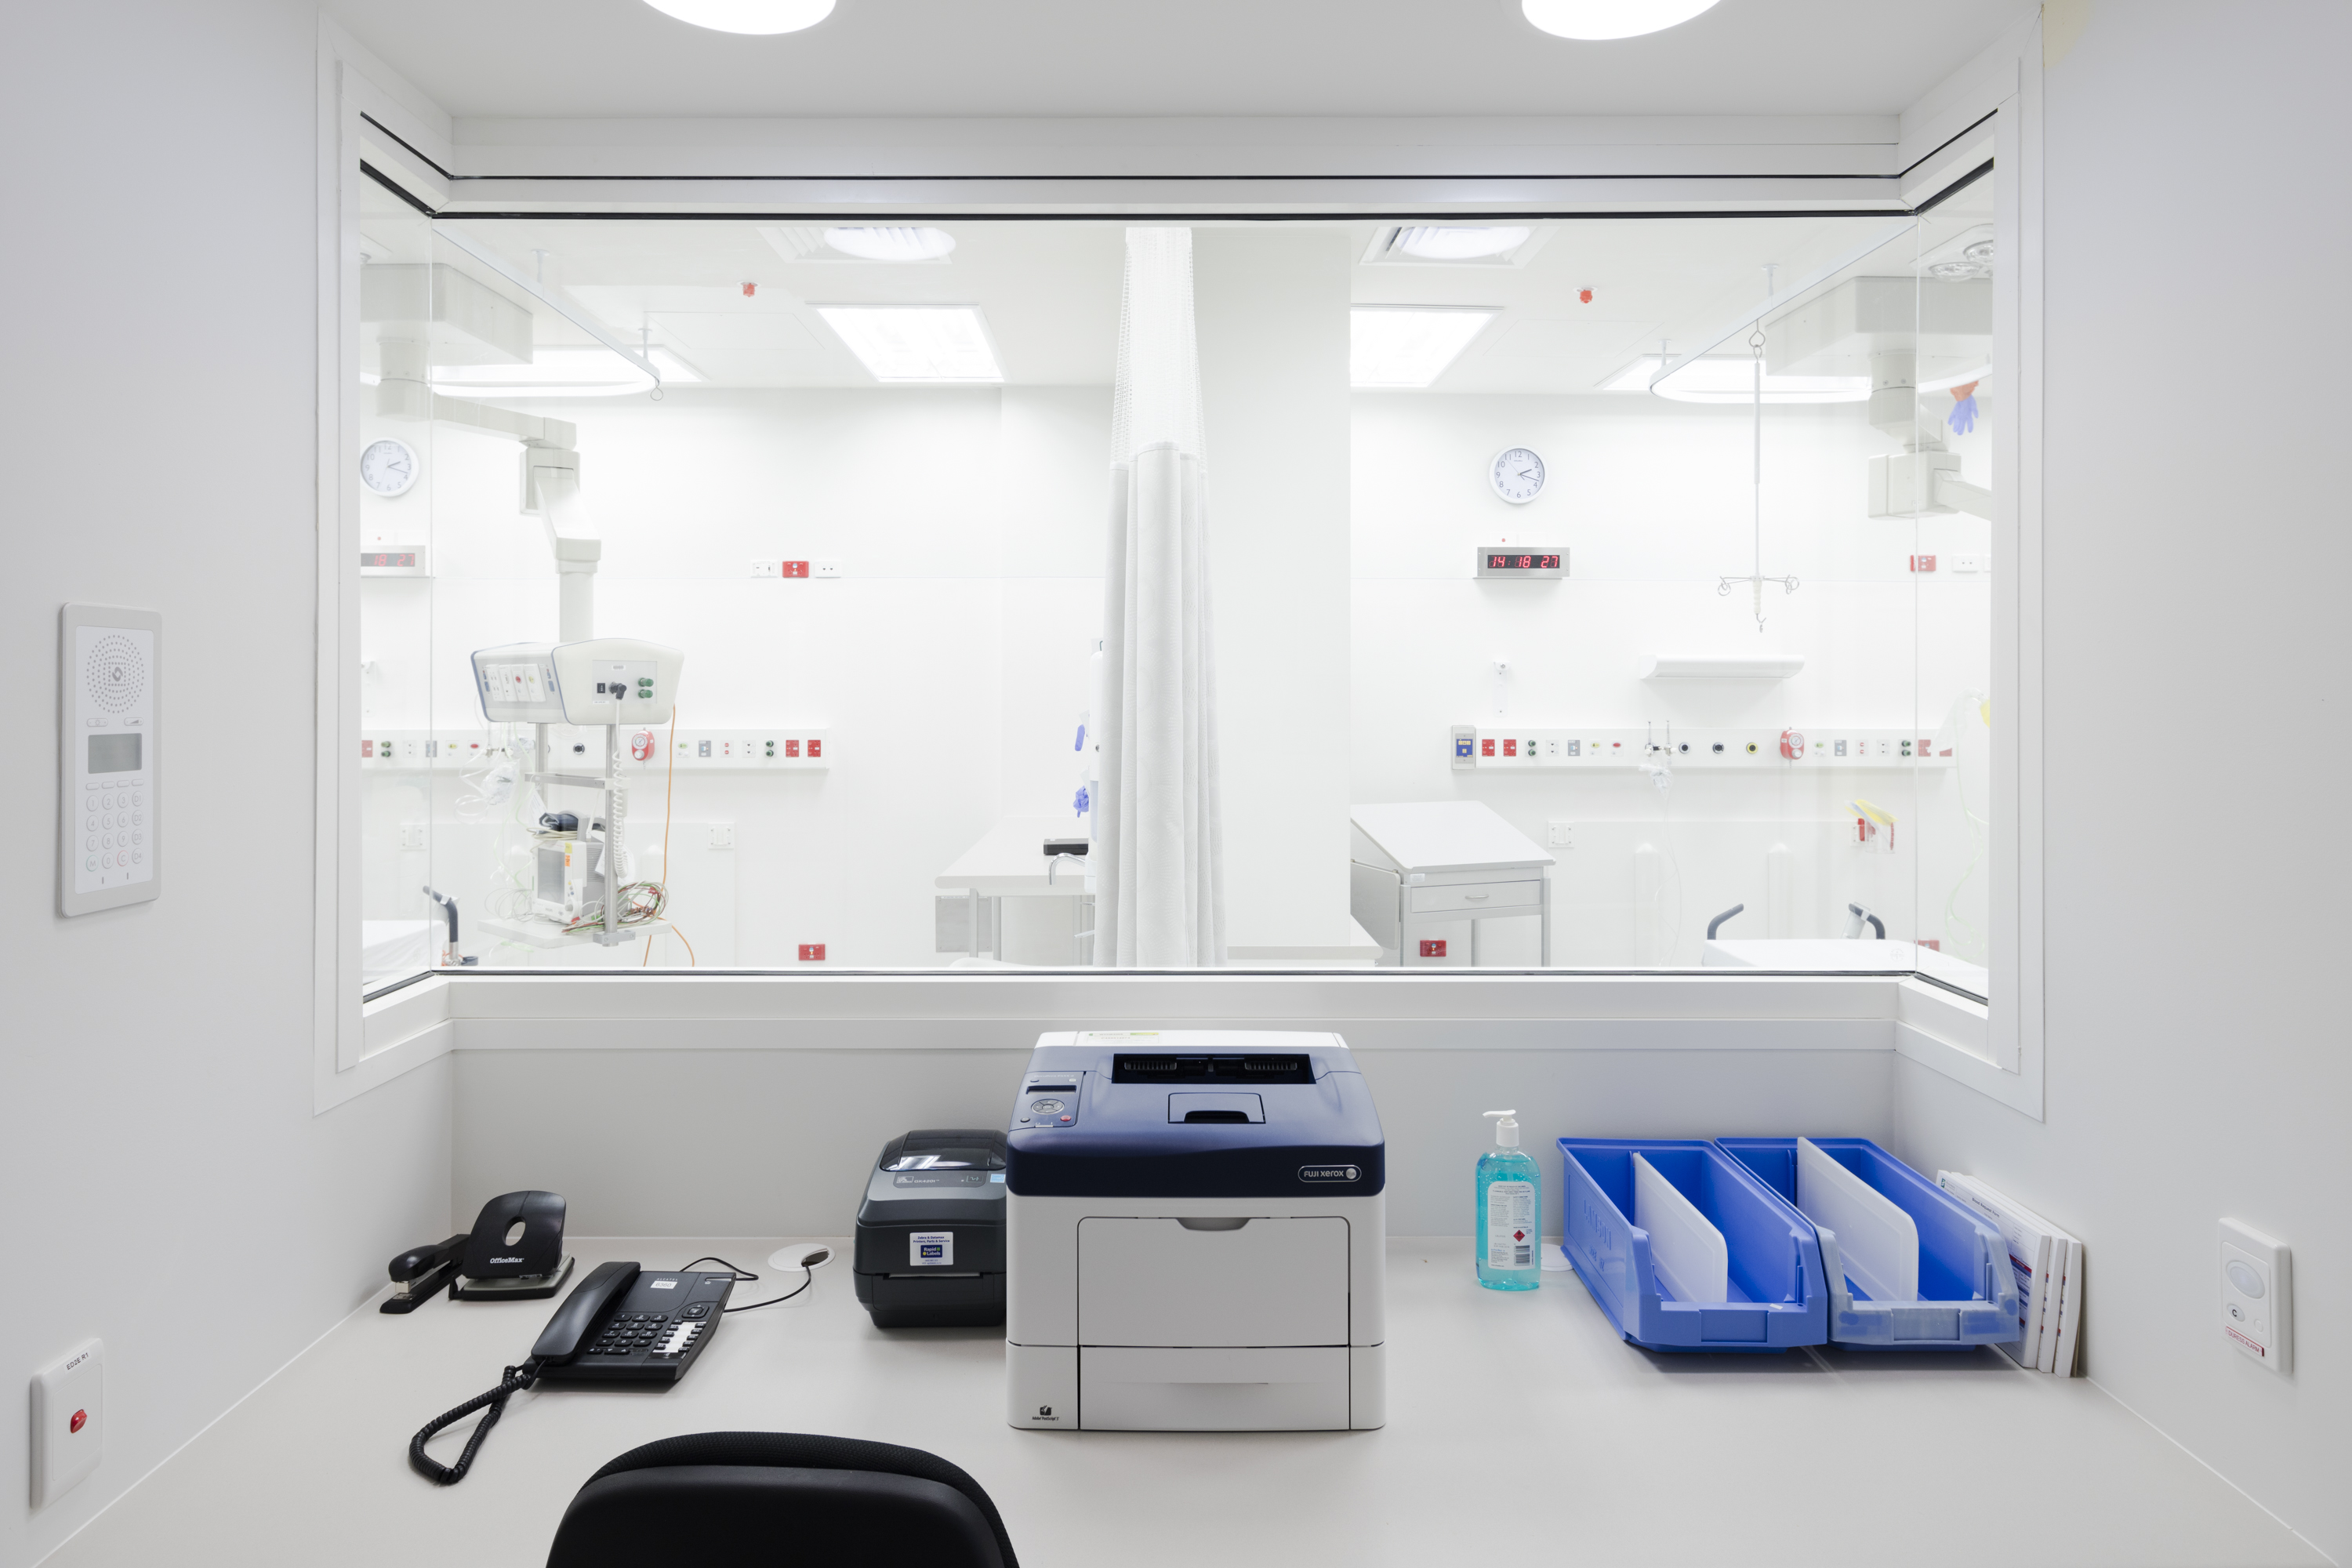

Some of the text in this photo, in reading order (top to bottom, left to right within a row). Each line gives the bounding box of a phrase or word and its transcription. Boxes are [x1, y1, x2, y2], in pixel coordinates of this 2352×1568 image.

[374, 554, 415, 566] 18 27
[1541, 555, 1559, 568] 27
[2228, 1330, 2259, 1352] DURESS ALARM
[66, 1352, 89, 1370] ED2E R1
